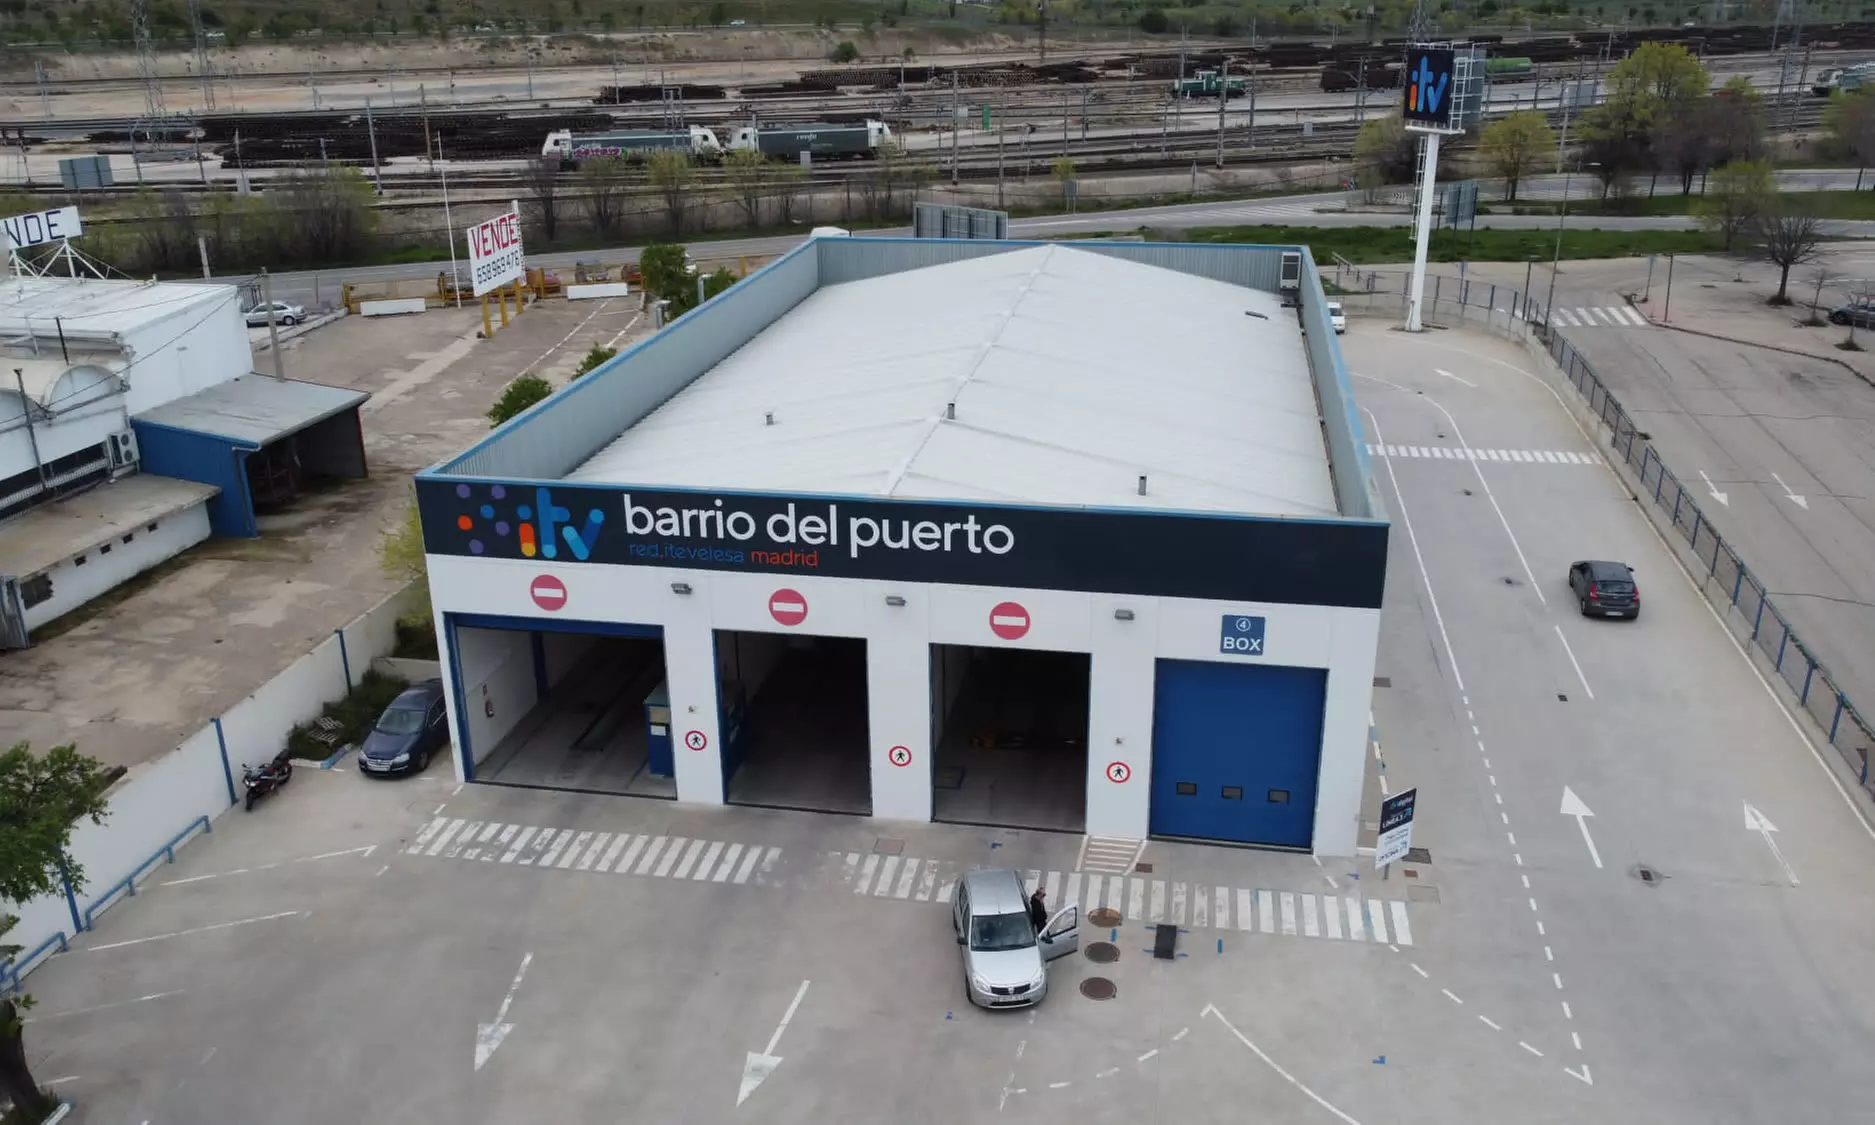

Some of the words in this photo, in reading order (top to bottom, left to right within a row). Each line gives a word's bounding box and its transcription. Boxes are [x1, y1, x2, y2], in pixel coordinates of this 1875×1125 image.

[1409, 56, 1448, 113] itv
[471, 213, 518, 259] VENDE
[517, 487, 604, 560] itv
[624, 494, 756, 541] barrio
[766, 502, 837, 544] del
[850, 514, 1015, 558] puerto
[629, 542, 745, 564] red.itevelesa
[751, 548, 819, 567] madrid
[1223, 636, 1261, 651] BOX
